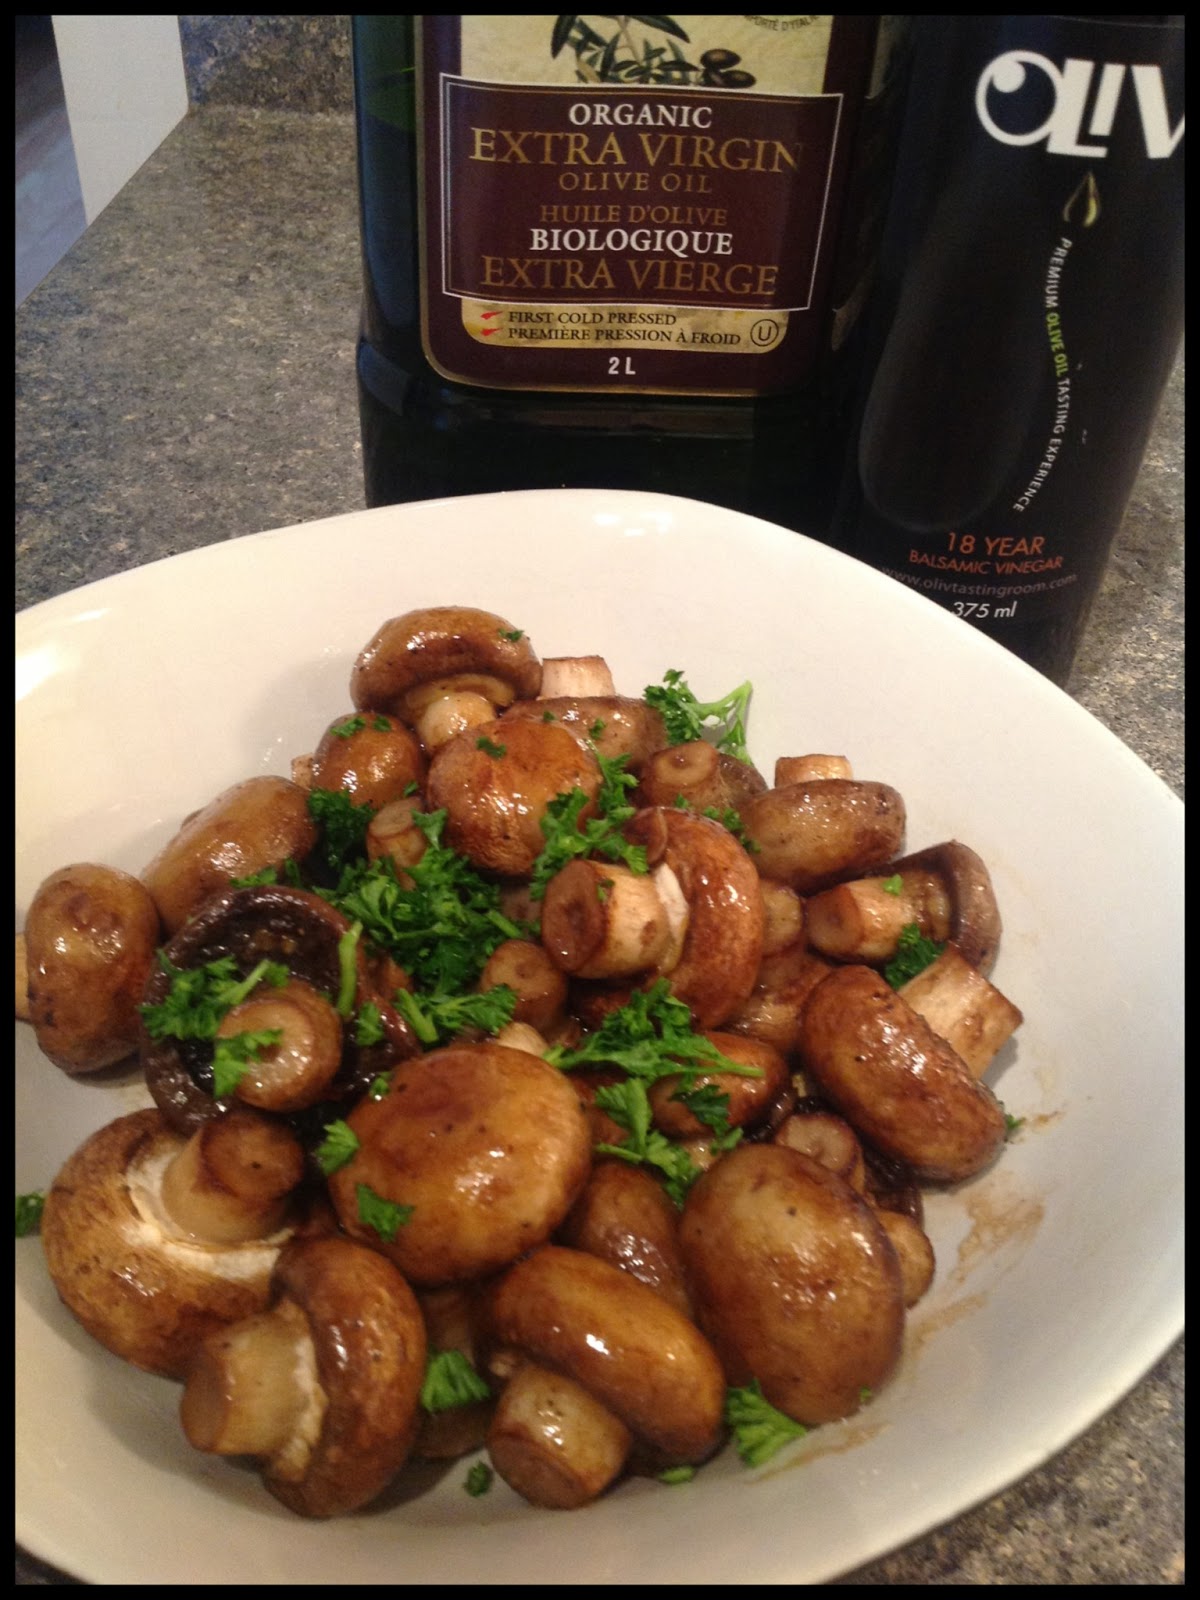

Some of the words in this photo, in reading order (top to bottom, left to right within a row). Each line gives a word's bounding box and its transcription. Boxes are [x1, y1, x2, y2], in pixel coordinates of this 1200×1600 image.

[569, 103, 713, 128] ORGANIC
[469, 128, 626, 164] EXTRA
[638, 134, 799, 173] VIRGIN
[559, 172, 650, 191] OLIVE
[661, 173, 713, 194] OIL
[540, 205, 621, 224] HUILE
[629, 205, 728, 226] D'OLIVE
[530, 228, 733, 257] BIOLOGIQUE
[481, 256, 614, 290] EXTRA
[628, 262, 779, 296] VIERGE
[1045, 236, 1073, 308] PREMIUM
[508, 311, 554, 325] FIRST
[557, 312, 604, 325] COLD
[606, 313, 677, 326] PRESSED
[508, 324, 591, 341] PREMIÈRE
[595, 329, 672, 343] PRESSION
[676, 327, 688, 344] À
[691, 333, 741, 346] FROID
[1046, 312, 1065, 351] OLIVE
[608, 357, 619, 375] 2
[625, 357, 636, 375] L
[1053, 353, 1068, 376] OIL
[1053, 378, 1070, 434] TASTING
[1012, 438, 1062, 512] EXPERIENCE
[948, 532, 975, 554] 18
[984, 536, 1045, 556] YEAR
[908, 550, 991, 574] BALSAMIC
[995, 556, 1064, 574] VINEGAR
[882, 567, 1078, 598] www.olivtastingroom.com
[952, 602, 990, 618] 375
[994, 601, 1017, 618] ml
